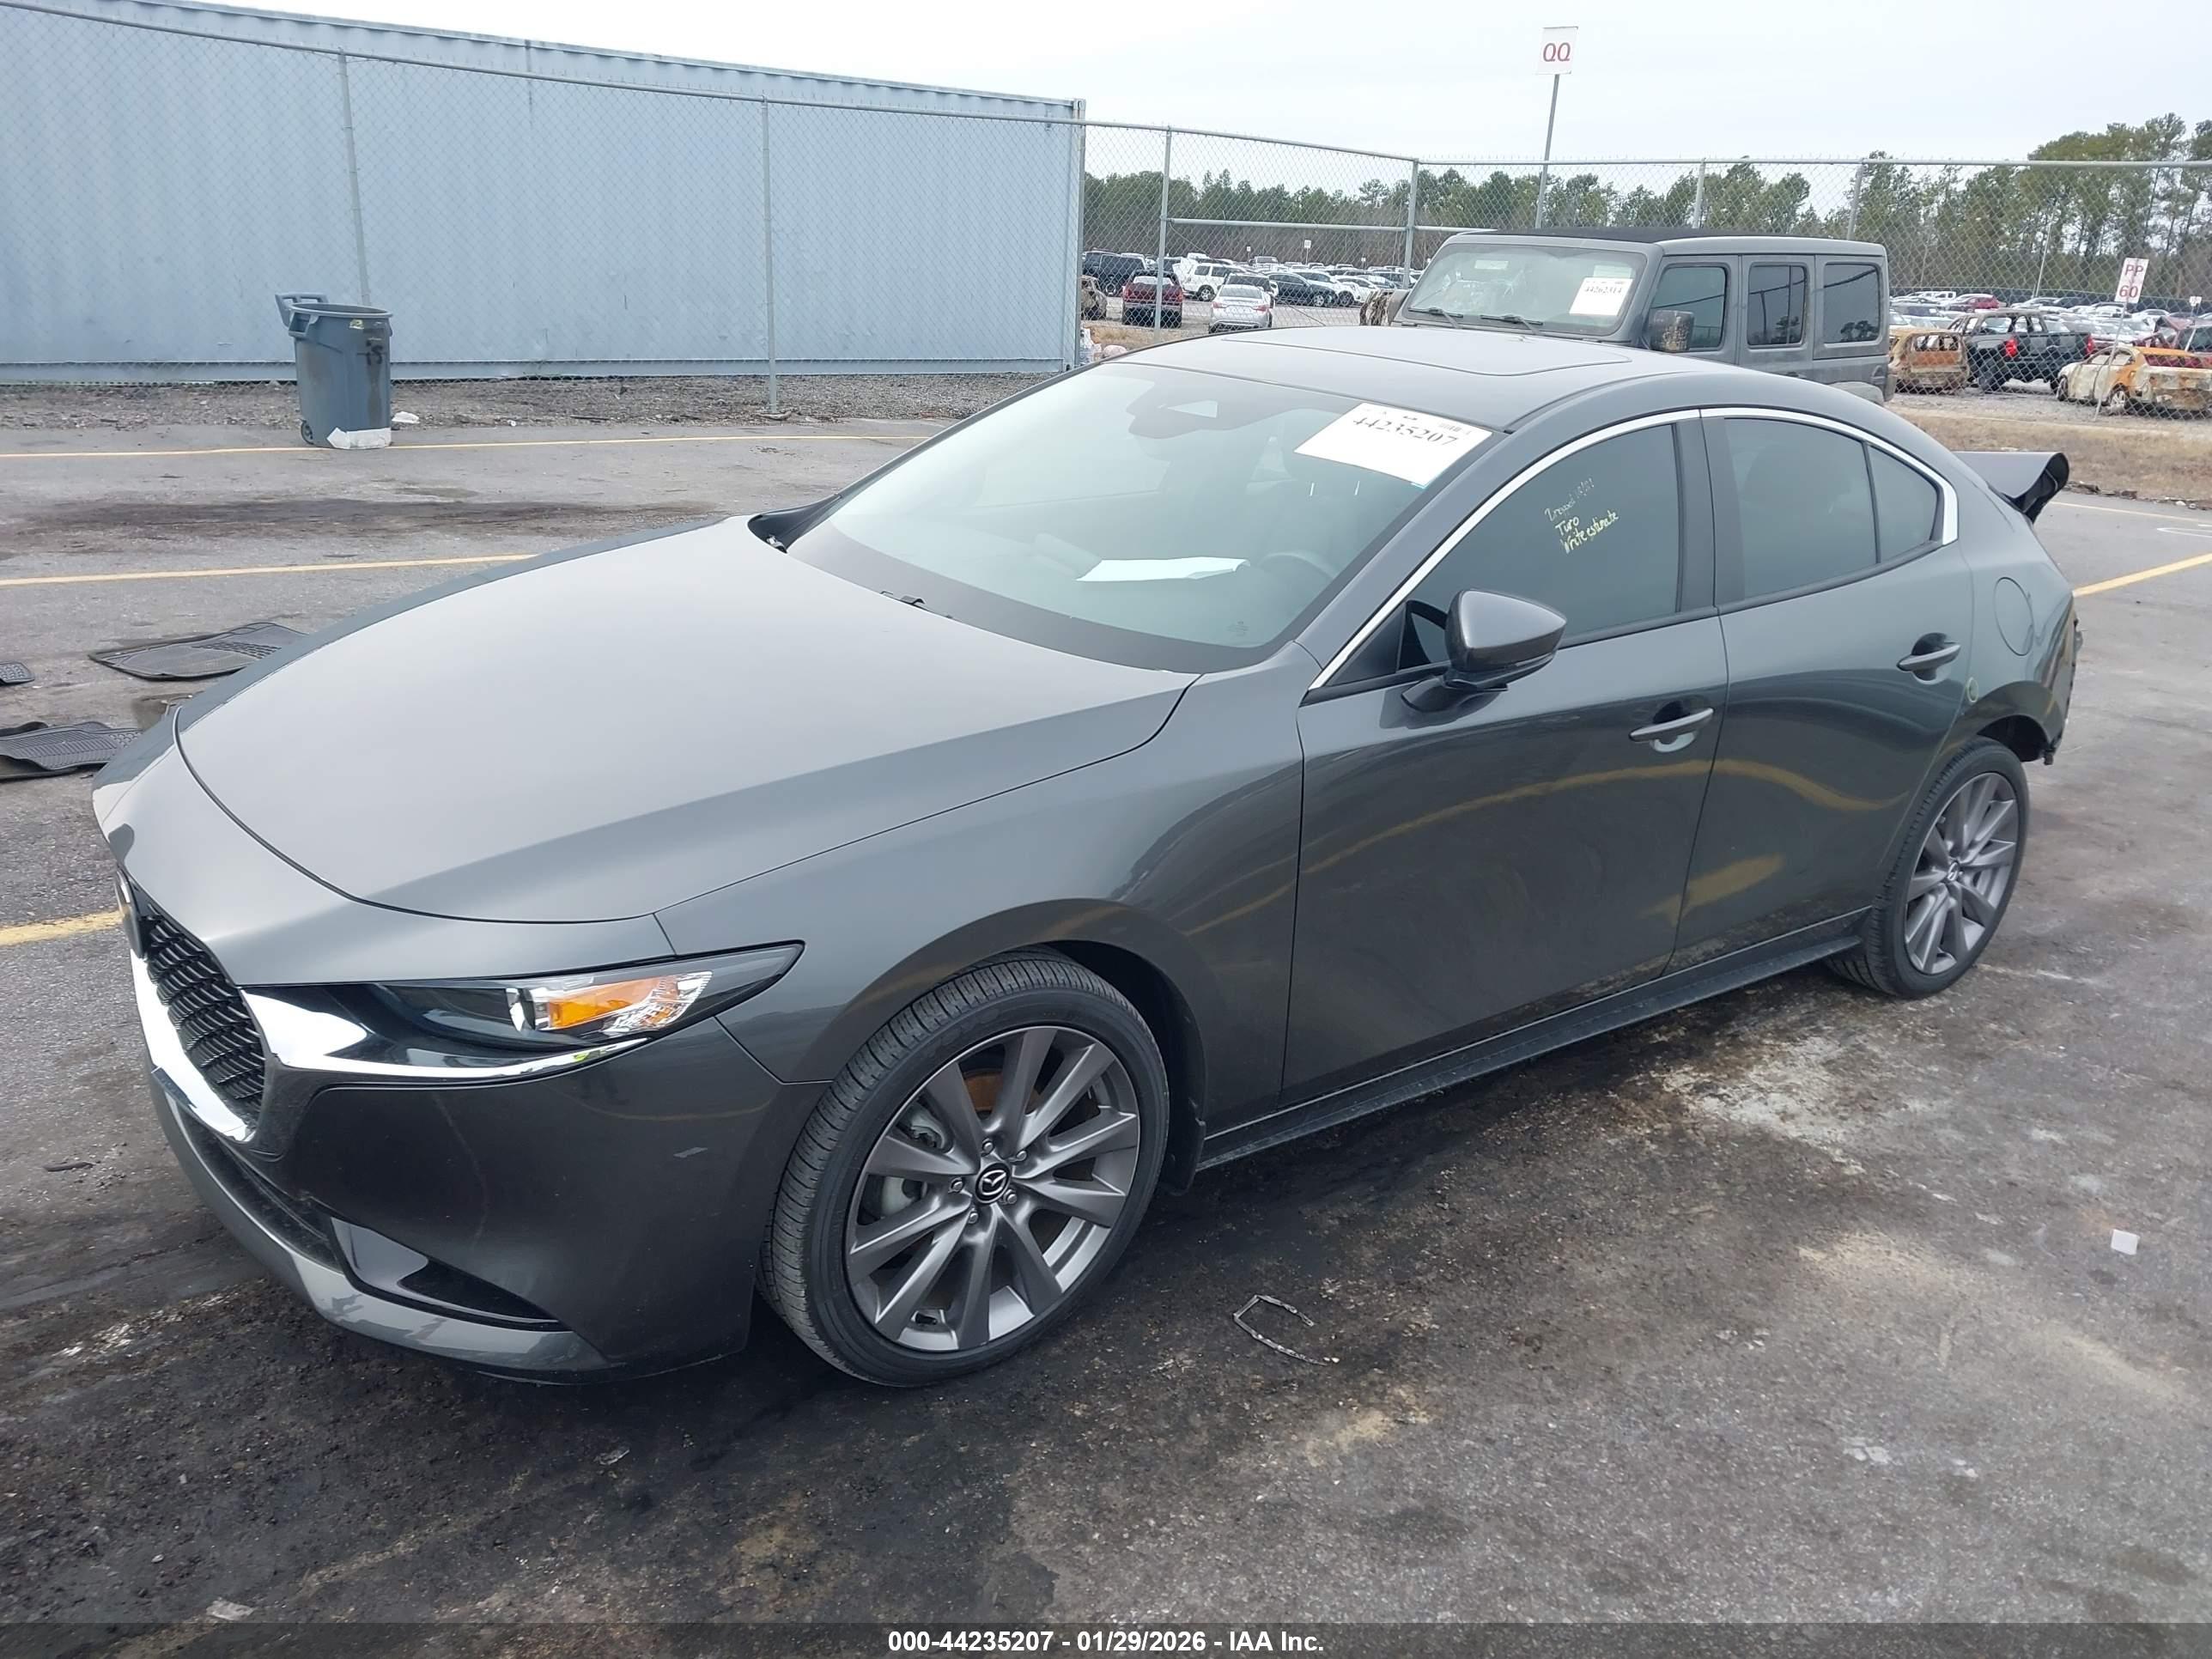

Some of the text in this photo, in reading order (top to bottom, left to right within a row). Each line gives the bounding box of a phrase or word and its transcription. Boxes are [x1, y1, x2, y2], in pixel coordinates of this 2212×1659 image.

[2124, 264, 2144, 276] PP
[2118, 285, 2139, 298] 60
[1352, 416, 1460, 446] 44235207
[1554, 515, 1580, 537] Turo
[1559, 509, 1620, 555] Write estimate
